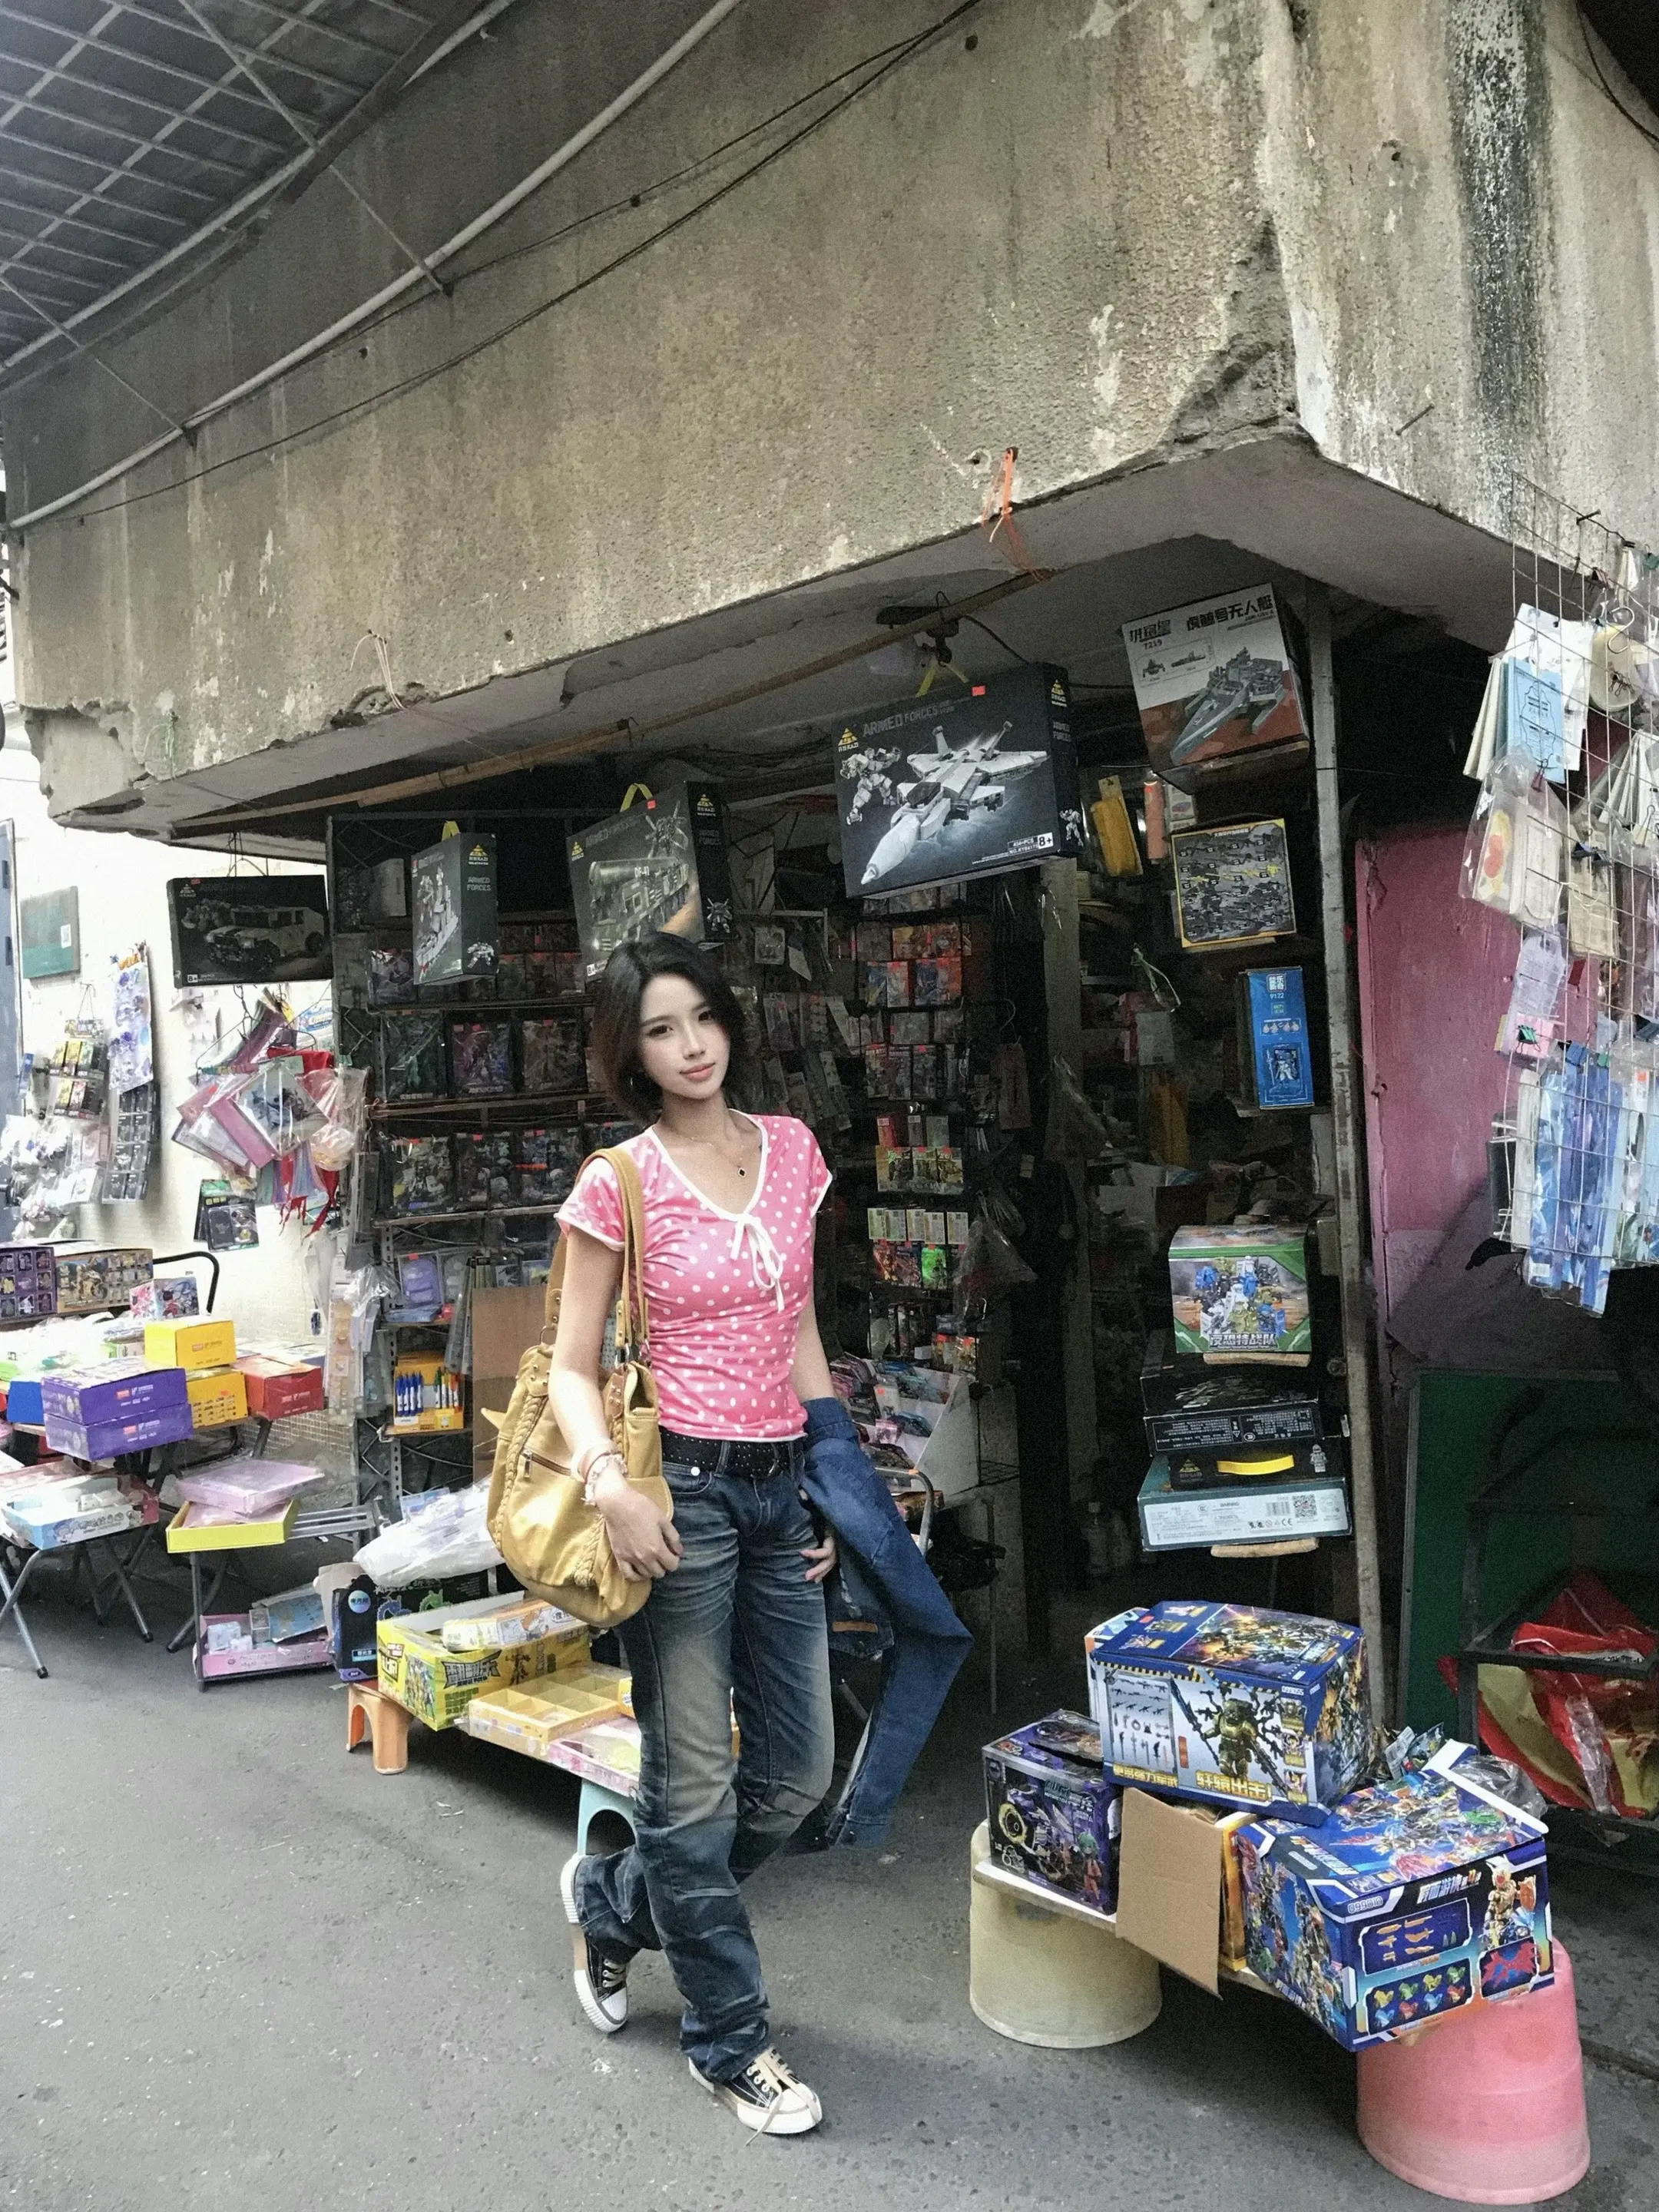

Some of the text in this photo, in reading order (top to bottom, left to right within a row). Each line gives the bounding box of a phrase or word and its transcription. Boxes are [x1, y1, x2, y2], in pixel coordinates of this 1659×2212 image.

[863, 714, 904, 737] ARMED
[904, 704, 939, 724] FORCES
[1038, 836, 1051, 846] 8+
[1210, 1333, 1277, 1346] 反恐特战队
